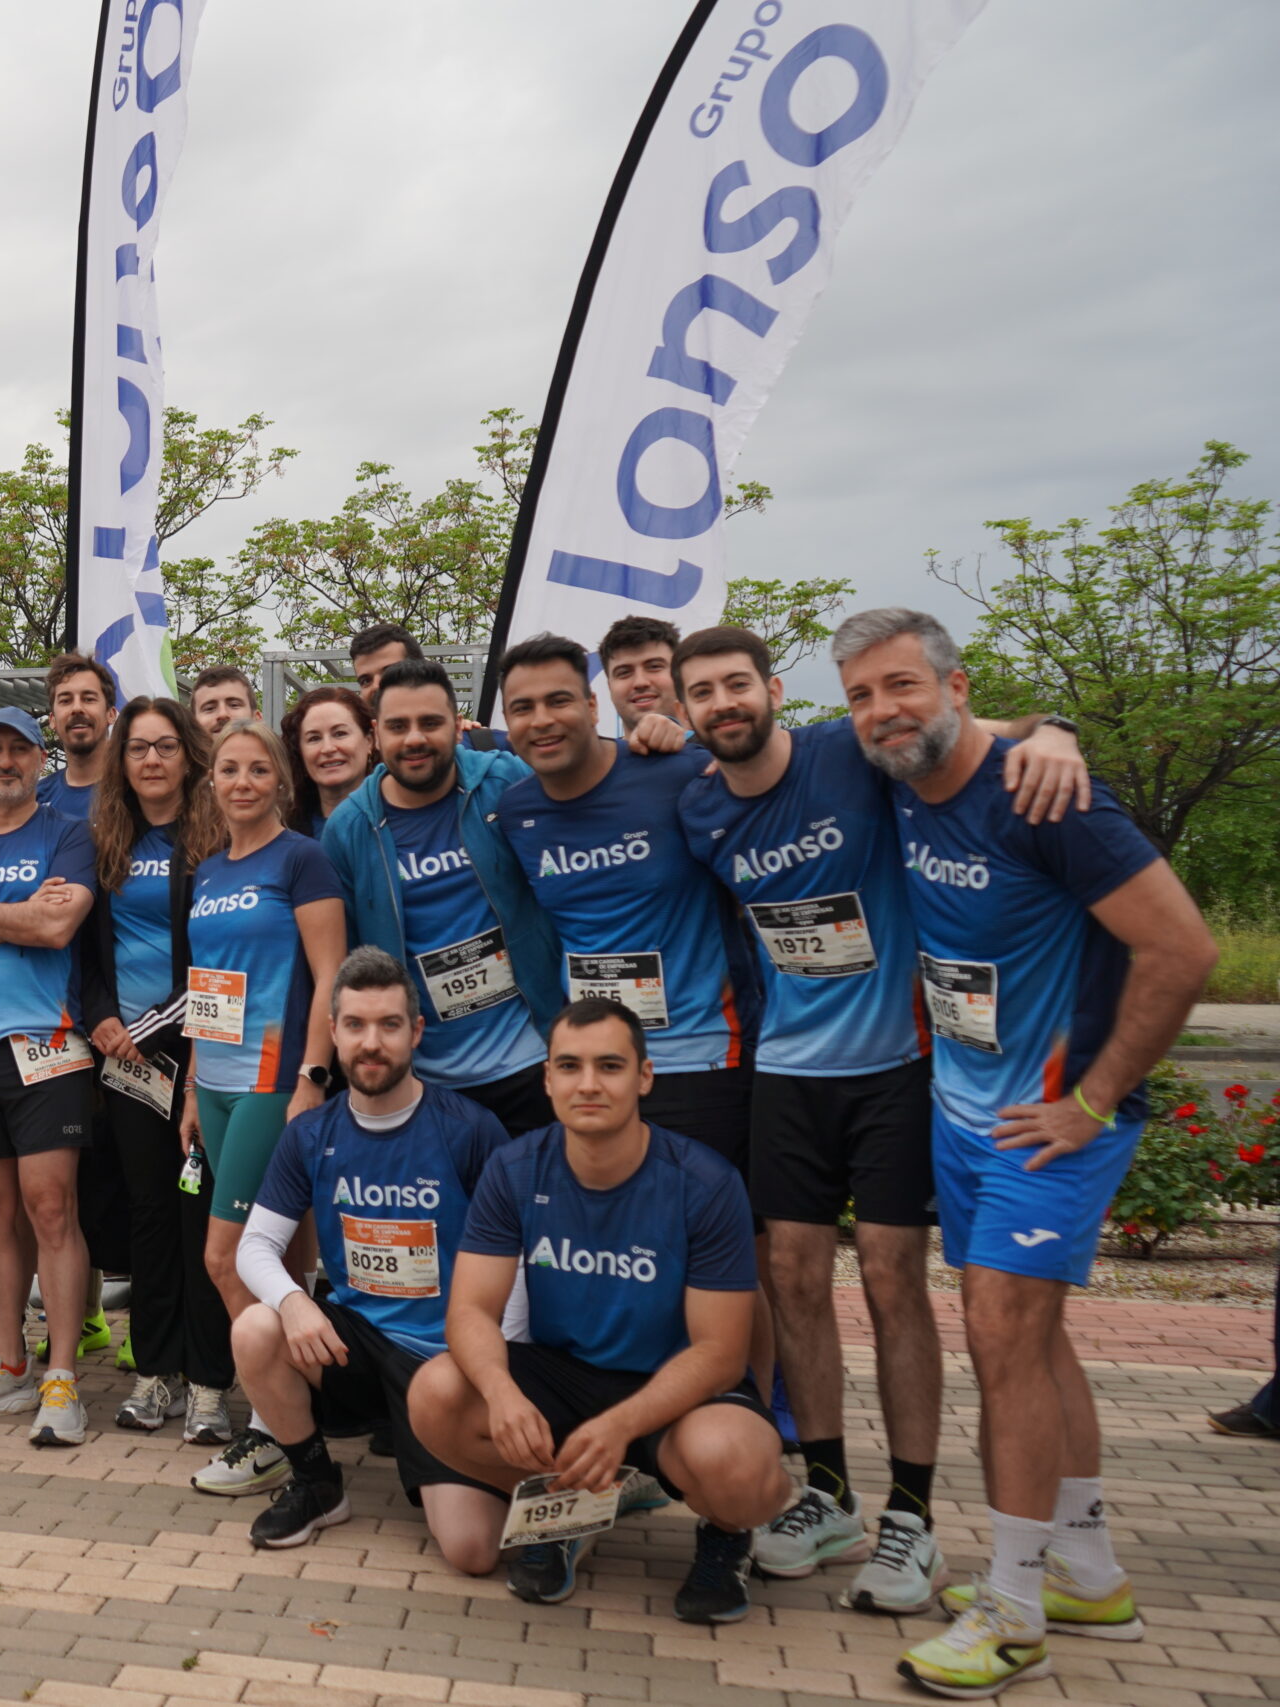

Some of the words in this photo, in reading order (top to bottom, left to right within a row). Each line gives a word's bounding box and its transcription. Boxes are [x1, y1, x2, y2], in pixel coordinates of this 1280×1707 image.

[113, 0, 138, 112] Grup
[689, 0, 783, 139] Grupo
[546, 23, 889, 610] lonso
[623, 830, 648, 840] Grupo
[398, 847, 471, 881] Alons
[539, 839, 650, 877] Alonso
[734, 827, 844, 883] Alonso
[773, 936, 826, 954] 1972
[441, 969, 488, 997] 1957
[190, 1000, 219, 1018] 7993
[116, 1059, 152, 1085] 1982
[63, 1125, 83, 1134] GORE
[333, 1176, 440, 1209] Alonso
[417, 1177, 440, 1187] Grupo
[351, 1251, 398, 1273] 8028
[528, 1236, 657, 1283] Alonso
[523, 1497, 579, 1524] 1997
